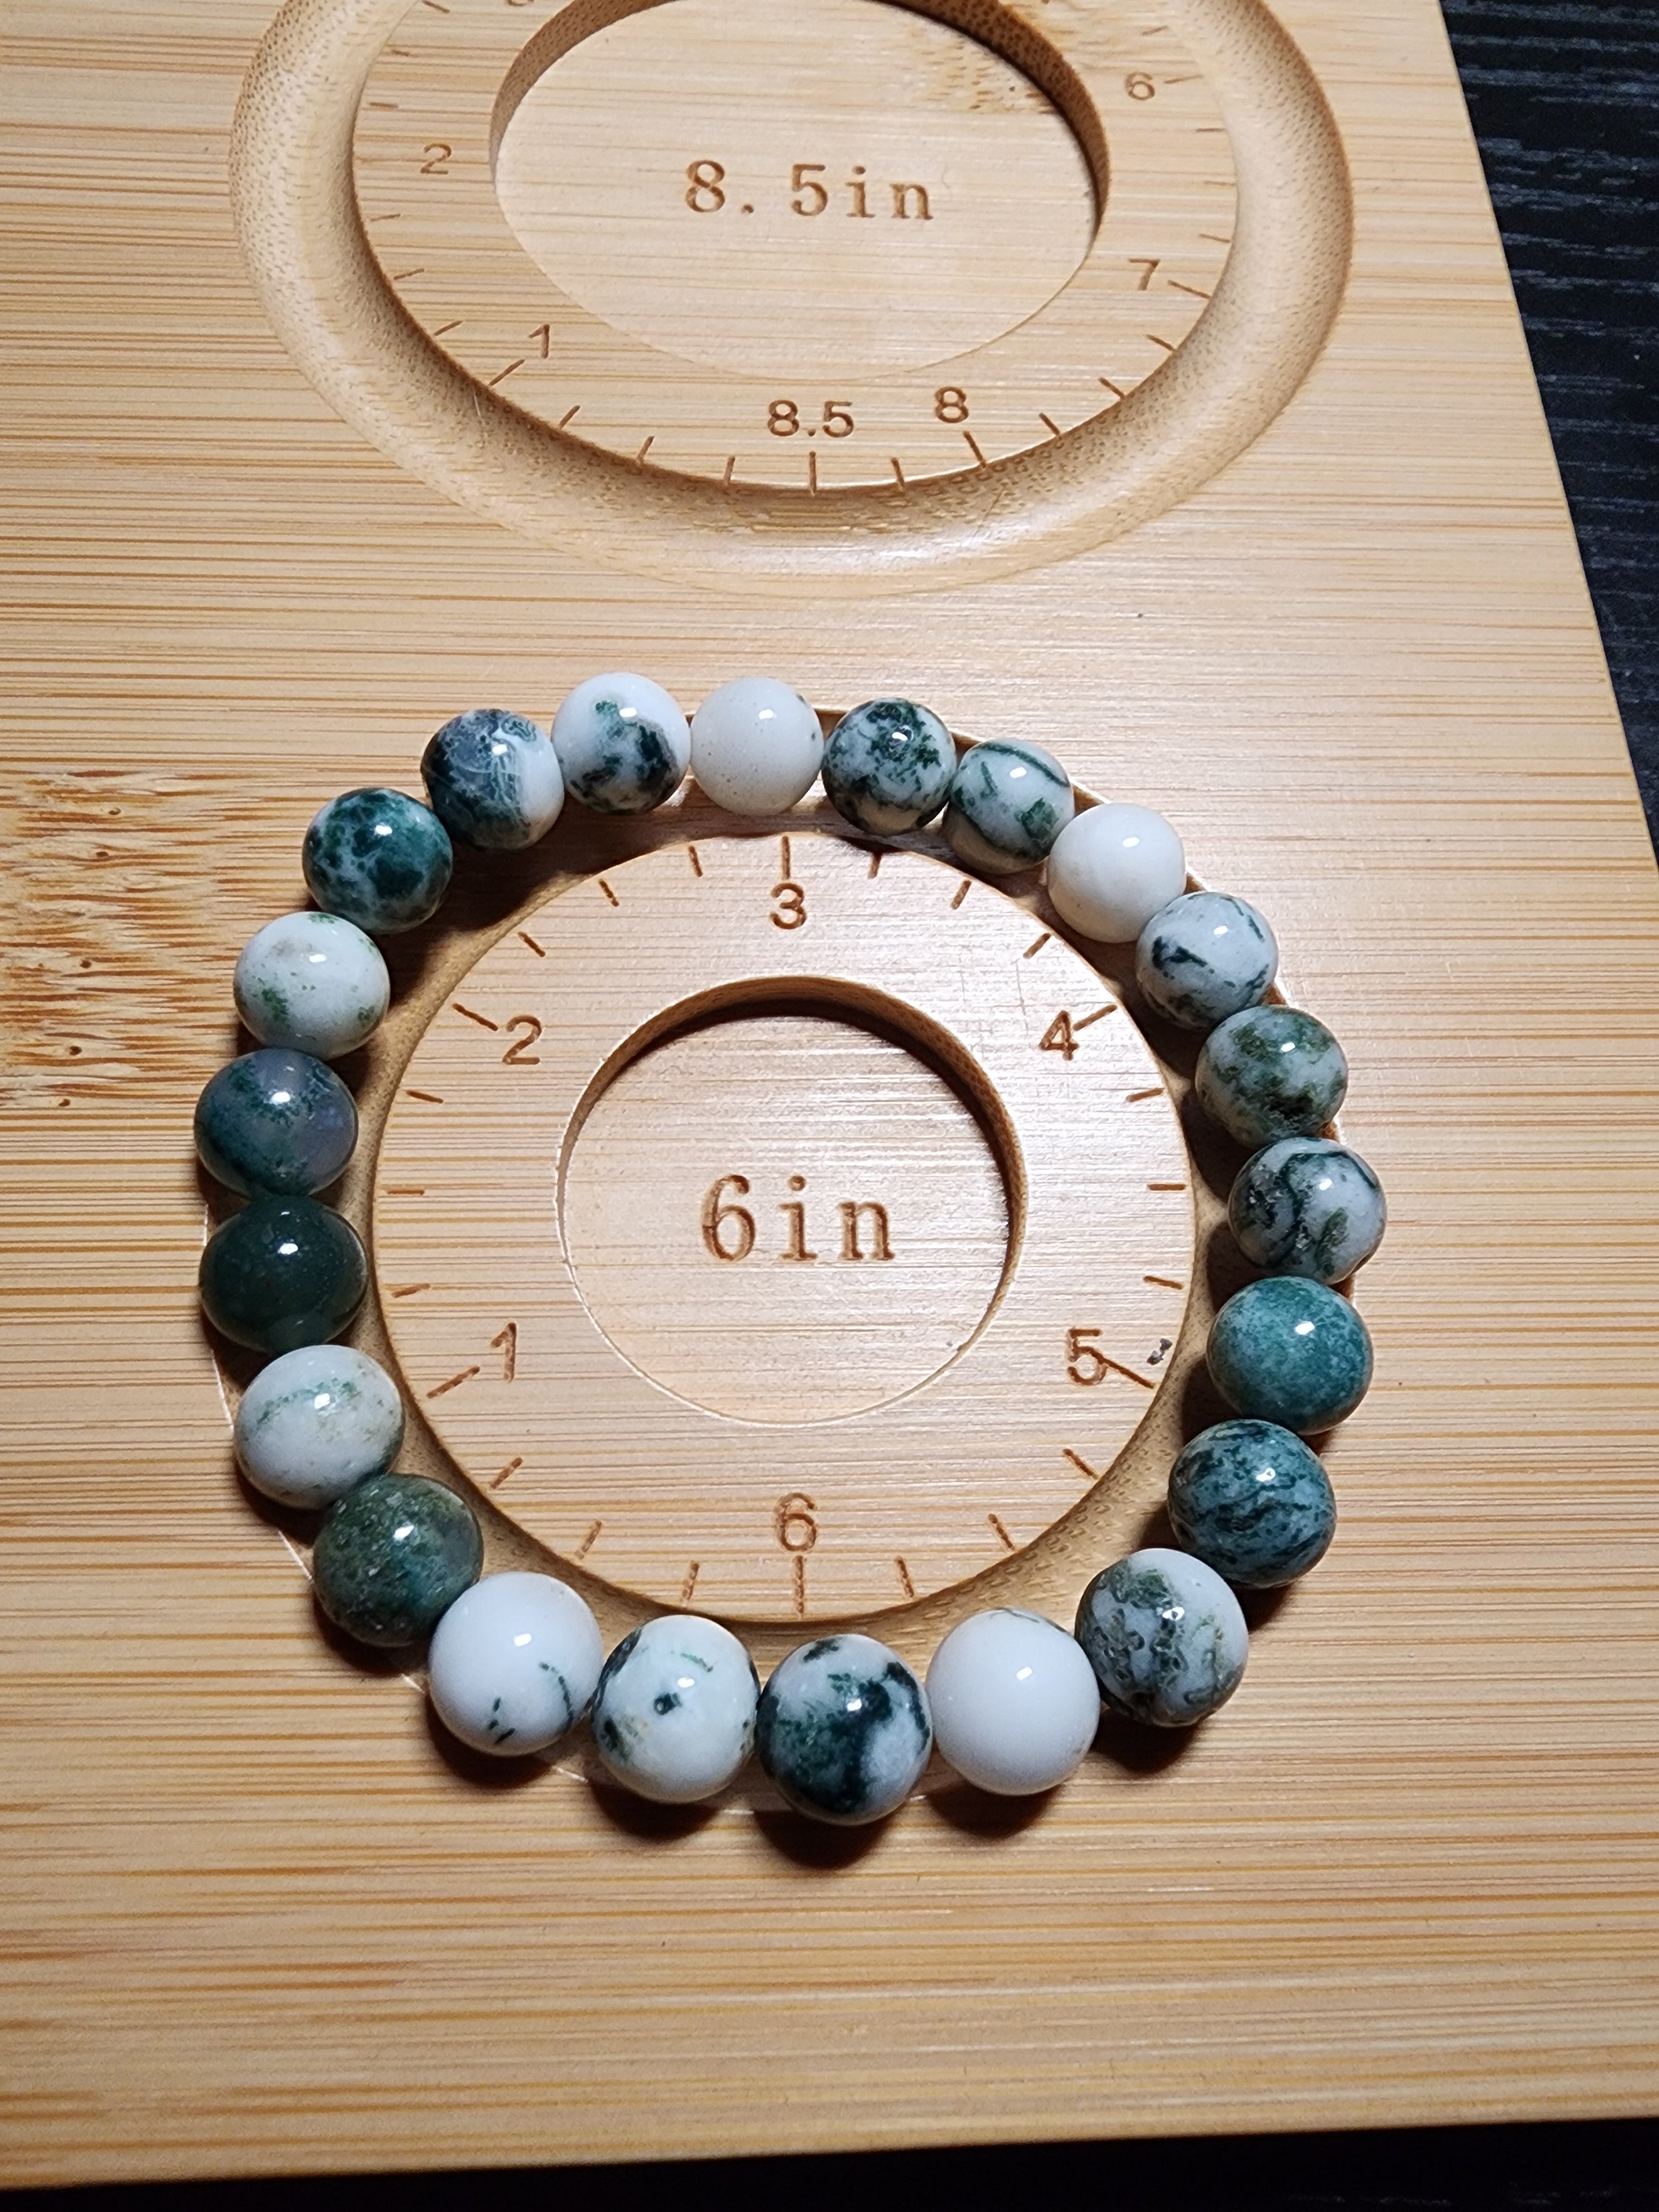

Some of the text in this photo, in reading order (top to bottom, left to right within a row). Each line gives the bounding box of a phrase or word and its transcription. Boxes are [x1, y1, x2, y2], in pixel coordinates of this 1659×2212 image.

[1125, 72, 1156, 102] 6
[420, 143, 452, 175] 2
[1129, 258, 1161, 291] 7
[527, 323, 552, 359] 1
[766, 399, 855, 439] 8.5
[933, 386, 970, 425] 8
[770, 882, 807, 930] 3
[500, 1014, 544, 1066] 2
[1038, 1010, 1079, 1061] 4
[700, 1174, 896, 1264] 6in
[490, 1321, 519, 1383] 1
[1066, 1328, 1107, 1386] 5
[774, 1493, 820, 1553] 6
